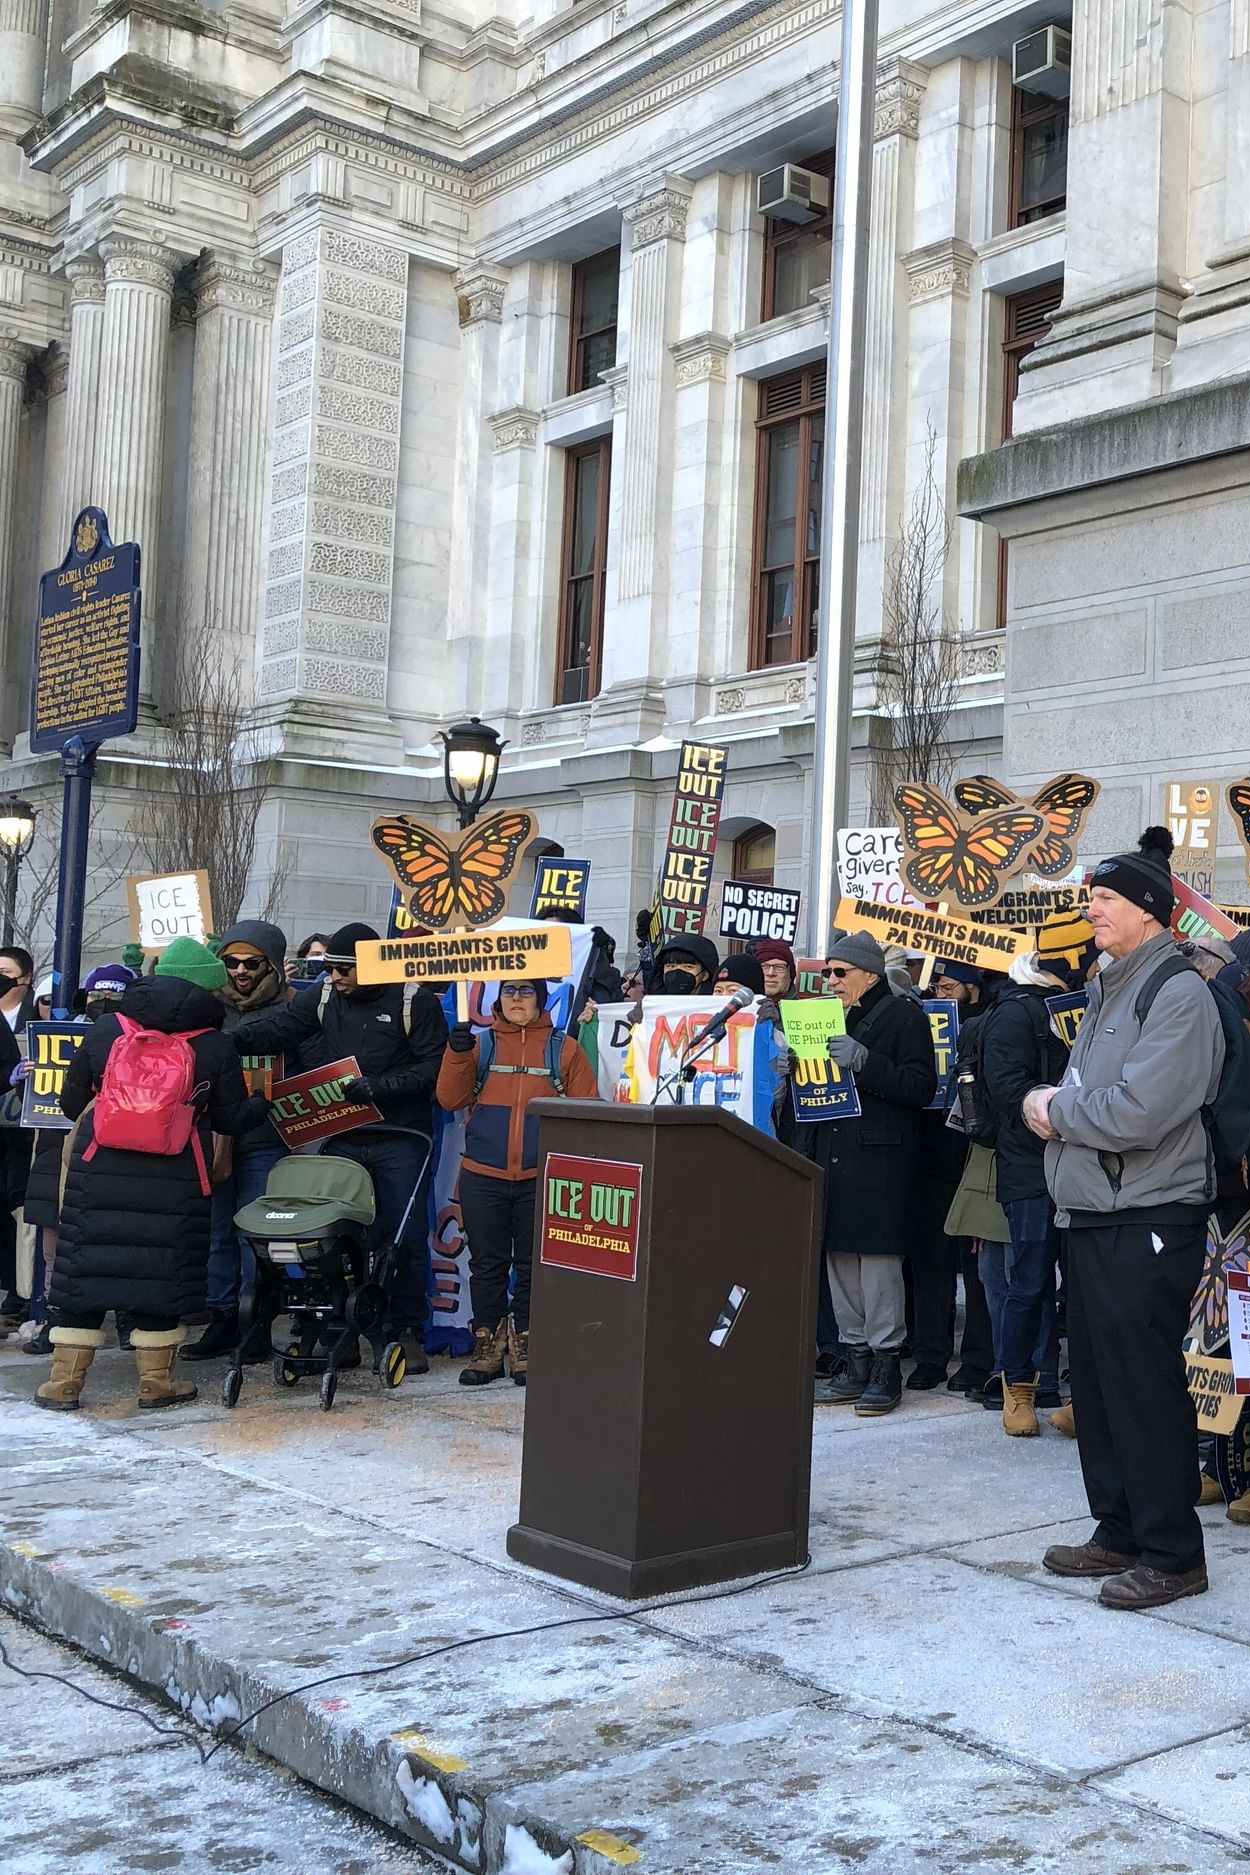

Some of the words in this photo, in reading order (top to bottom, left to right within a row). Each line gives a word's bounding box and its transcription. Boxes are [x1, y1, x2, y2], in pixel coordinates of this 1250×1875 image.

[58, 568, 81, 586] GLORIA
[84, 556, 116, 577] CASAREZ
[684, 744, 725, 773] ICE
[679, 772, 722, 798] OUT
[676, 798, 717, 828] ICE
[672, 826, 714, 852] OUT
[667, 852, 709, 881] ICE
[541, 868, 584, 896] ICE
[662, 878, 706, 904] OUT
[150, 887, 186, 909] ICE
[724, 885, 744, 904] NO
[748, 891, 798, 912] SECRET
[152, 914, 196, 936] OUT
[662, 906, 702, 934] ICE
[722, 906, 796, 942] POLICE
[854, 900, 968, 943] IMMIGRANTS
[970, 931, 1016, 954] MAKE
[380, 937, 494, 961] IMMIGRANTS
[496, 934, 548, 952] GROW
[886, 928, 908, 947] PA
[911, 934, 978, 965] STRONG
[404, 953, 526, 978] COMMUNITIES
[787, 1020, 802, 1030] ICE
[804, 1021, 822, 1030] out
[826, 1019, 836, 1030] of
[36, 1034, 85, 1066] IC
[789, 1035, 800, 1044] NE
[802, 1034, 829, 1044] Phill
[800, 1092, 848, 1106] PHILLY
[814, 1088, 828, 1096] OF
[285, 1104, 370, 1134] PHILADELPHIA
[548, 1178, 583, 1220] ICE
[590, 1184, 635, 1228] OUT
[548, 1228, 630, 1254] PHILADELPHIA
